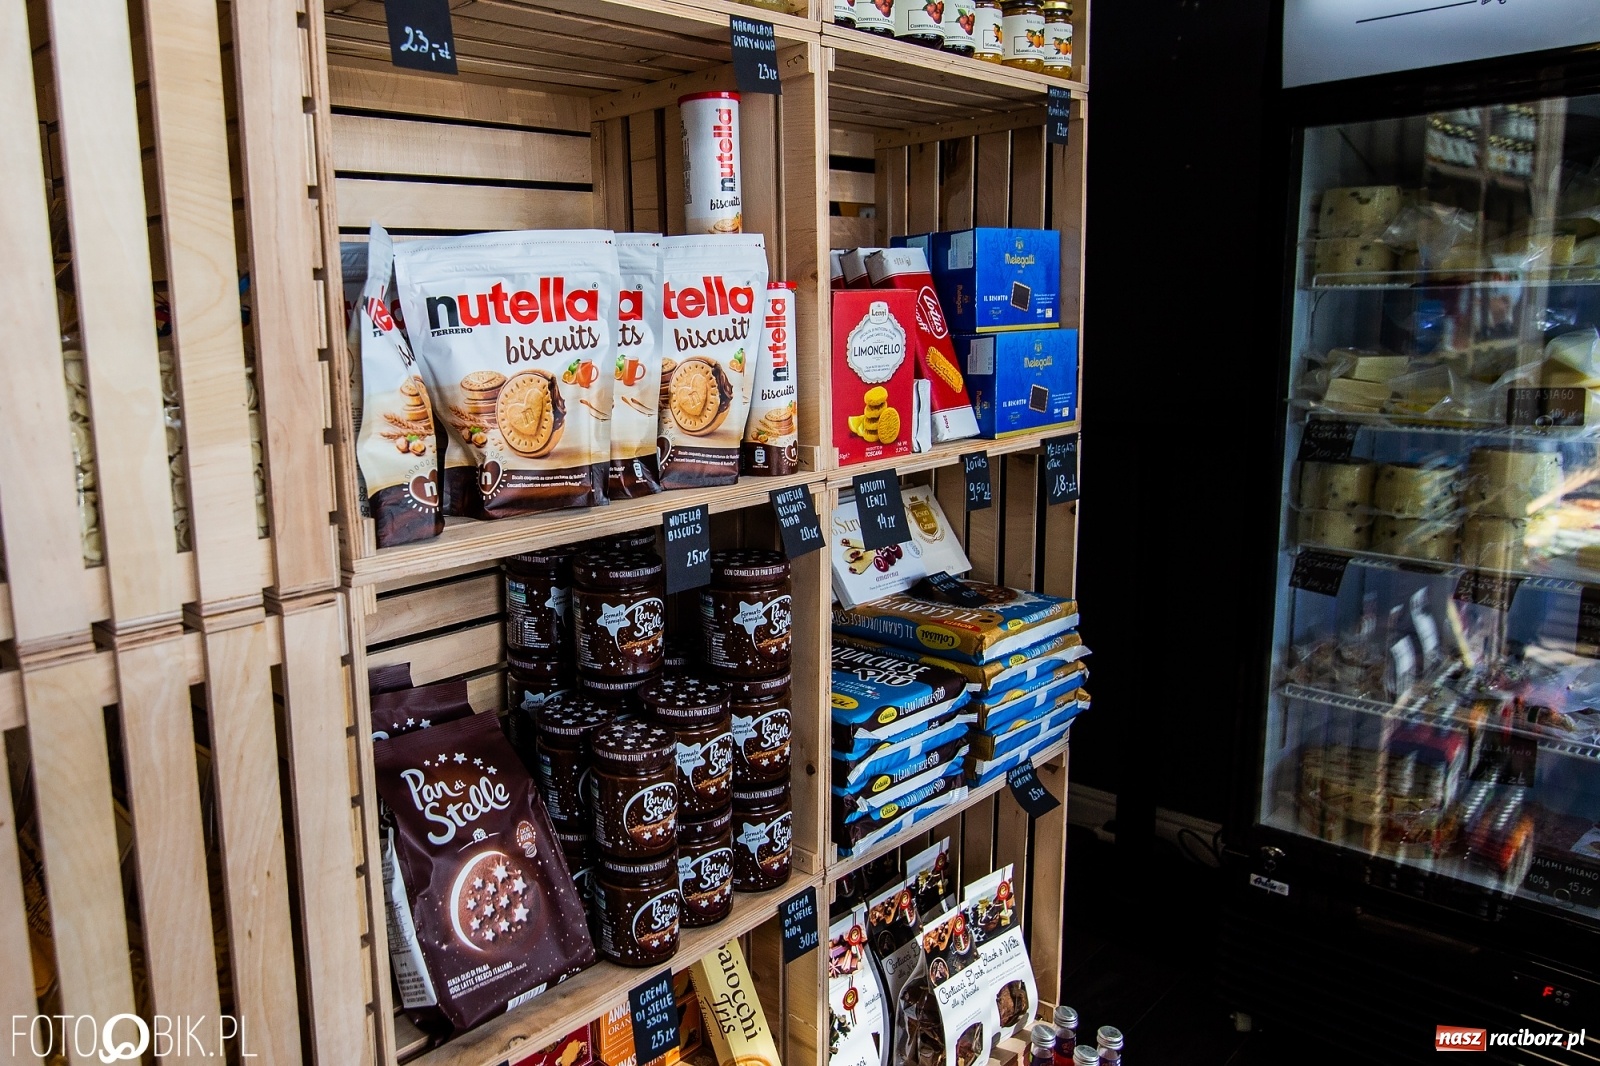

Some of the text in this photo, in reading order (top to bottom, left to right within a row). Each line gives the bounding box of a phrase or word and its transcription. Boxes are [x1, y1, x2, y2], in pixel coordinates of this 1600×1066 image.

[732, 20, 773, 37] MARMOLADA
[713, 108, 734, 192] nutella
[710, 196, 740, 211] biscuits
[1004, 253, 1035, 268] Melegatti
[426, 276, 599, 330] nutella
[662, 275, 754, 320] tella
[923, 294, 944, 334] Lotus
[430, 327, 473, 338] FERRERO
[673, 316, 750, 352] biscuit
[765, 298, 786, 382] nutella
[504, 324, 601, 365] biscuits
[854, 344, 900, 357] LIMONCELLO
[1024, 356, 1053, 370] Melegatti
[761, 384, 795, 401] biscuits
[860, 480, 886, 494] BISCOTTI
[777, 488, 804, 505] NUTELLA
[866, 492, 888, 508] LENZI
[669, 508, 701, 527] NUTELLA
[778, 500, 807, 517] BISCUITS
[668, 523, 702, 542] BISCUTS
[604, 610, 624, 620] Formato
[605, 616, 626, 626] Famiglia
[634, 606, 651, 620] Pan
[740, 609, 761, 619] Formato
[771, 603, 786, 621] Pan
[850, 612, 914, 639] IL GRANTURCHESE
[920, 629, 955, 647] Colussi
[666, 708, 688, 717] GRANELLA
[761, 717, 778, 734] Pan
[760, 724, 789, 748] Stelle
[678, 750, 699, 759] Formato
[709, 742, 724, 761] Pan
[400, 768, 467, 811] Pan di
[643, 790, 661, 806] Pan
[424, 776, 511, 846] Stelle
[642, 797, 674, 821] Stelle
[773, 822, 788, 839] Pan
[700, 858, 719, 876] Pan
[700, 862, 730, 890] Stelle
[652, 900, 669, 916] Pan
[788, 895, 809, 914] CREMA
[784, 906, 813, 928] DI STELLE
[981, 948, 998, 966] Black
[460, 972, 470, 981] OLIO
[460, 978, 474, 991] LATTE
[475, 970, 492, 983] FRESCO
[938, 980, 966, 1005] Cantucci
[965, 964, 986, 986] Dark
[640, 980, 668, 1006] CREMA
[718, 938, 762, 1042] aiocchi
[636, 992, 673, 1022] DI STELLE
[712, 992, 736, 1034] Tris
